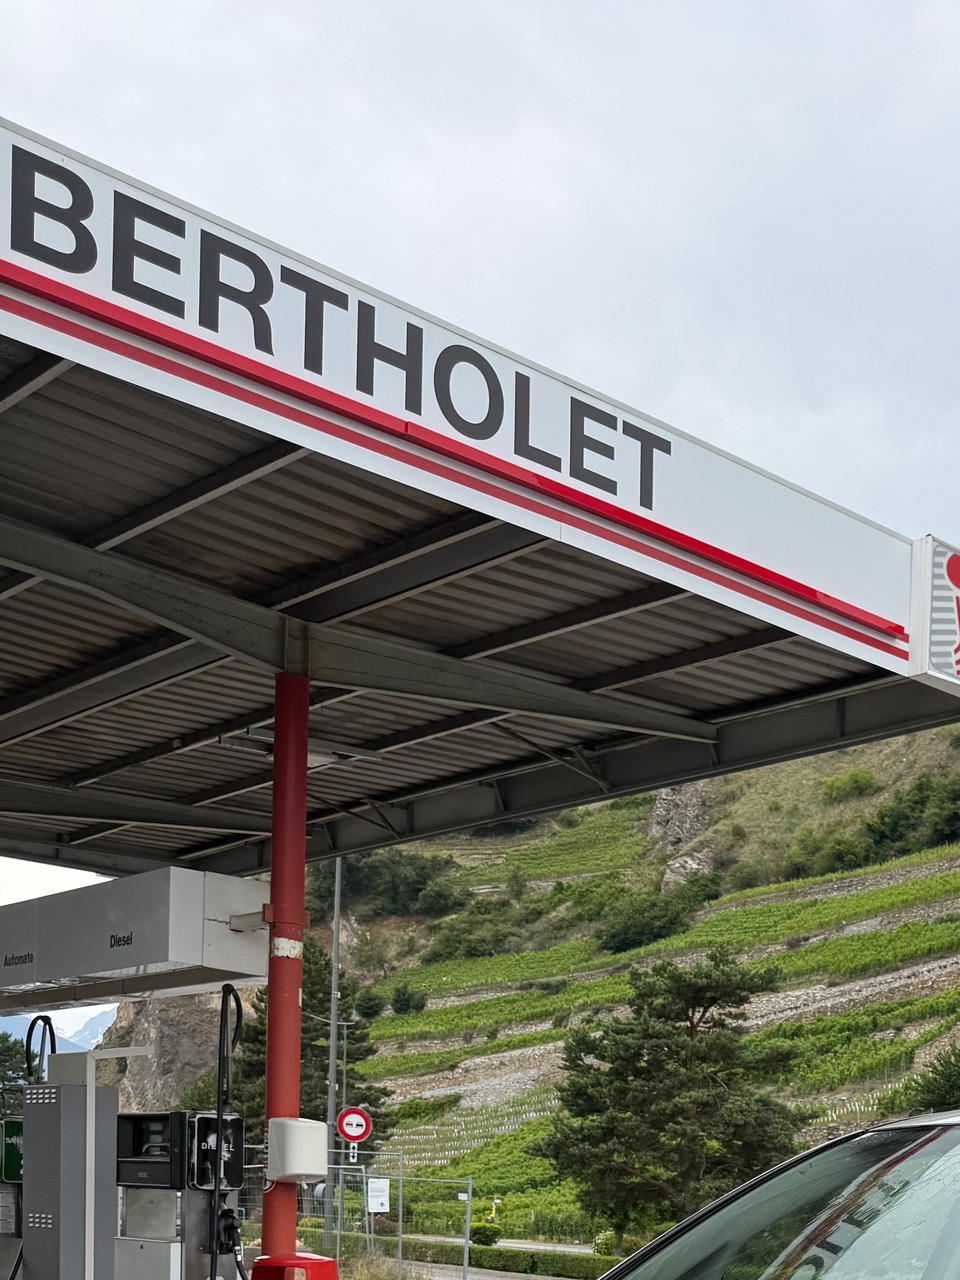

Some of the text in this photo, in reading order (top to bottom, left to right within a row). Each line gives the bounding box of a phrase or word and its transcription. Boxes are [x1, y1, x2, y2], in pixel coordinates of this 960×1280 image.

[10, 143, 672, 511] BERTHOLET
[109, 932, 133, 948] Diesel
[3, 951, 34, 967] Automate
[201, 1142, 235, 1151] DIEEL
